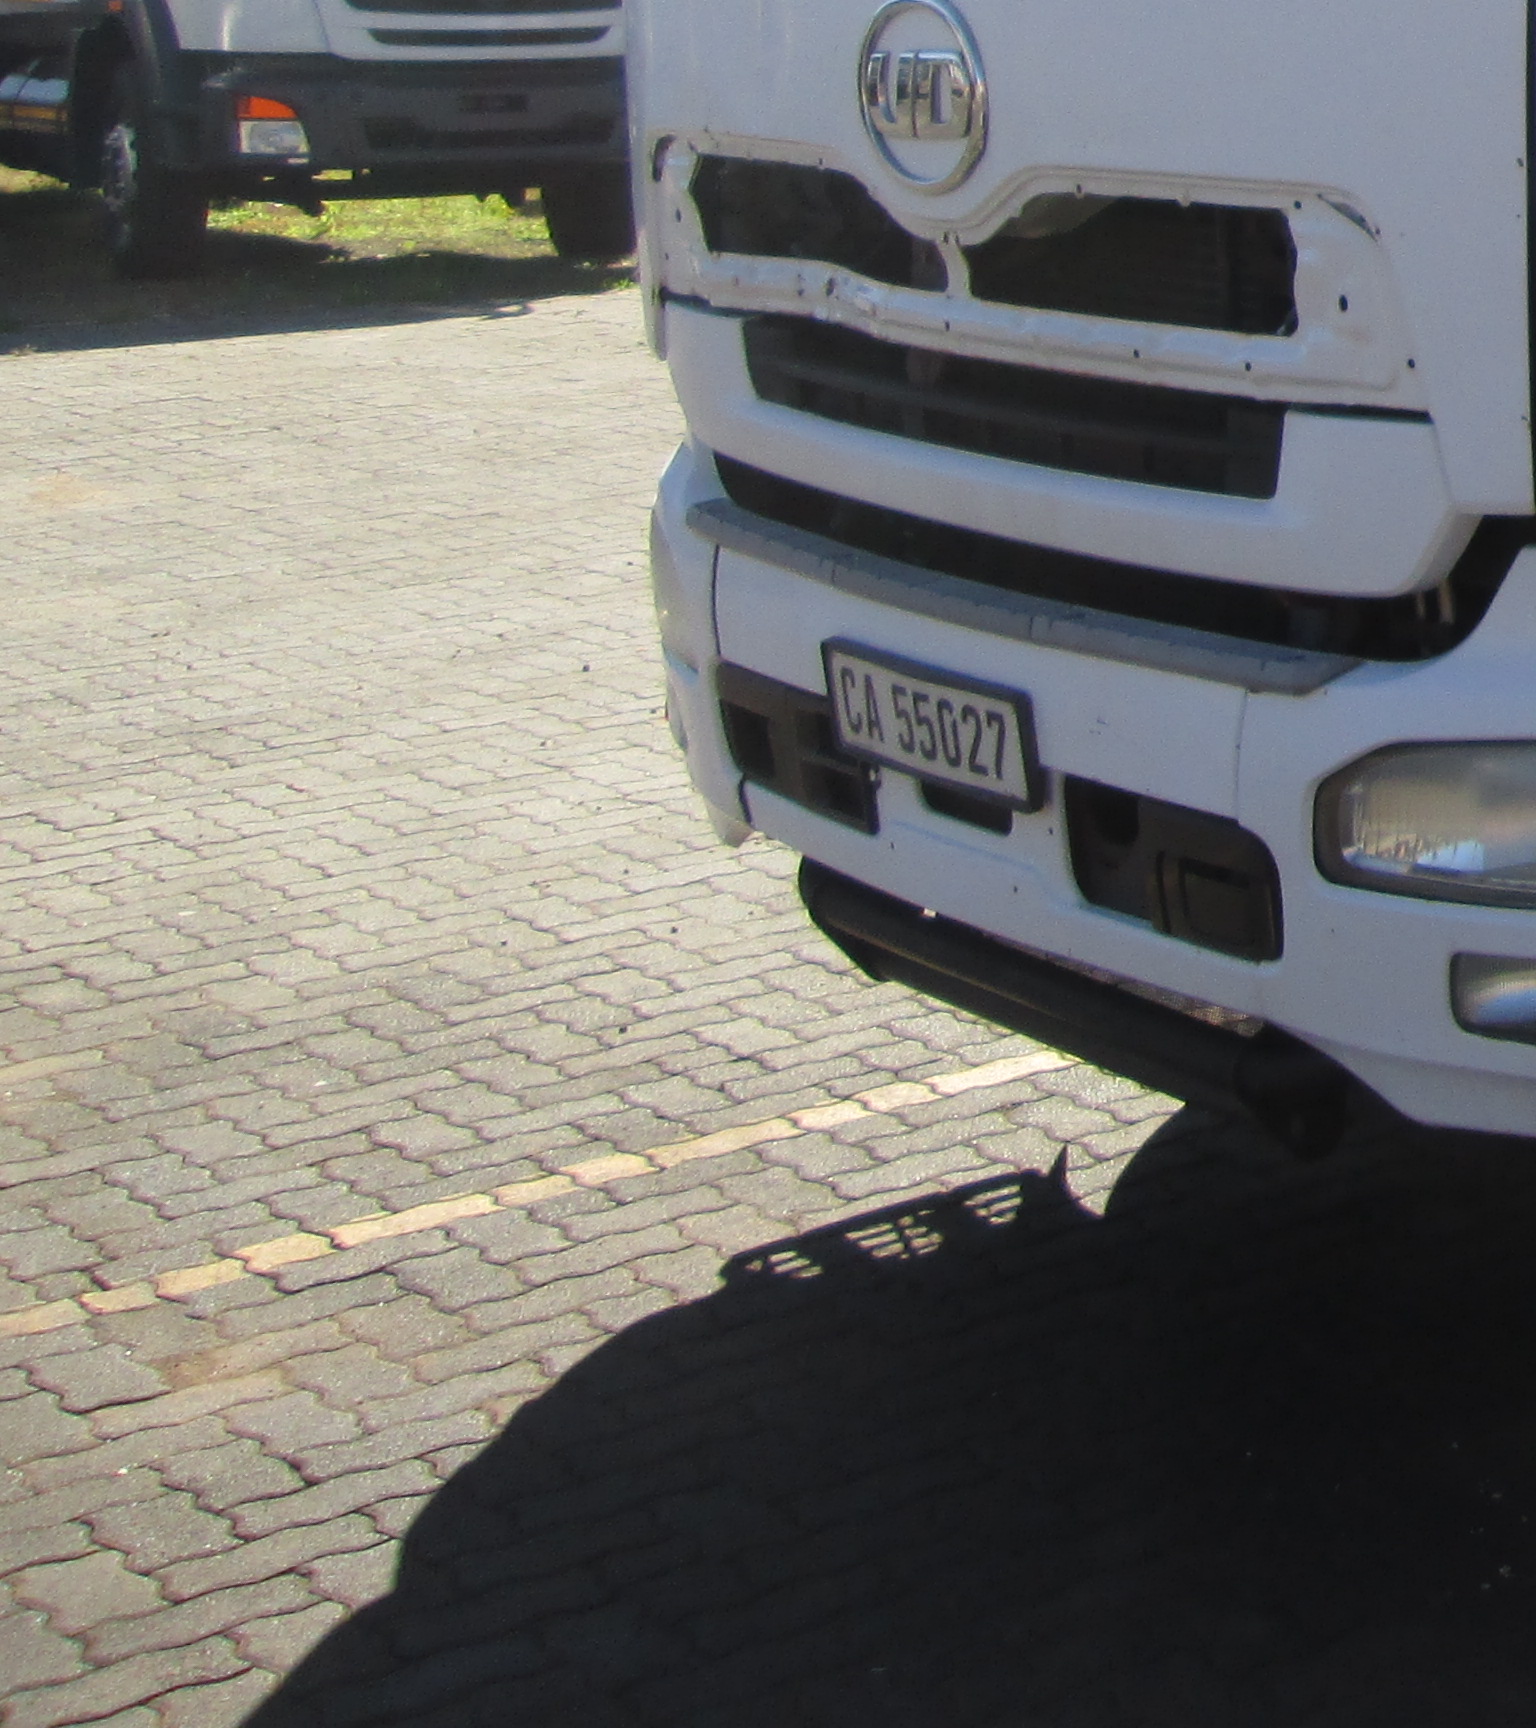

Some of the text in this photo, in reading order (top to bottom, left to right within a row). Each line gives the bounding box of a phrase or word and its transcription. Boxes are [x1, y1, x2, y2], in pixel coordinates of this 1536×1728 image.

[867, 49, 976, 141] UD
[840, 666, 1006, 781] CA 55027
